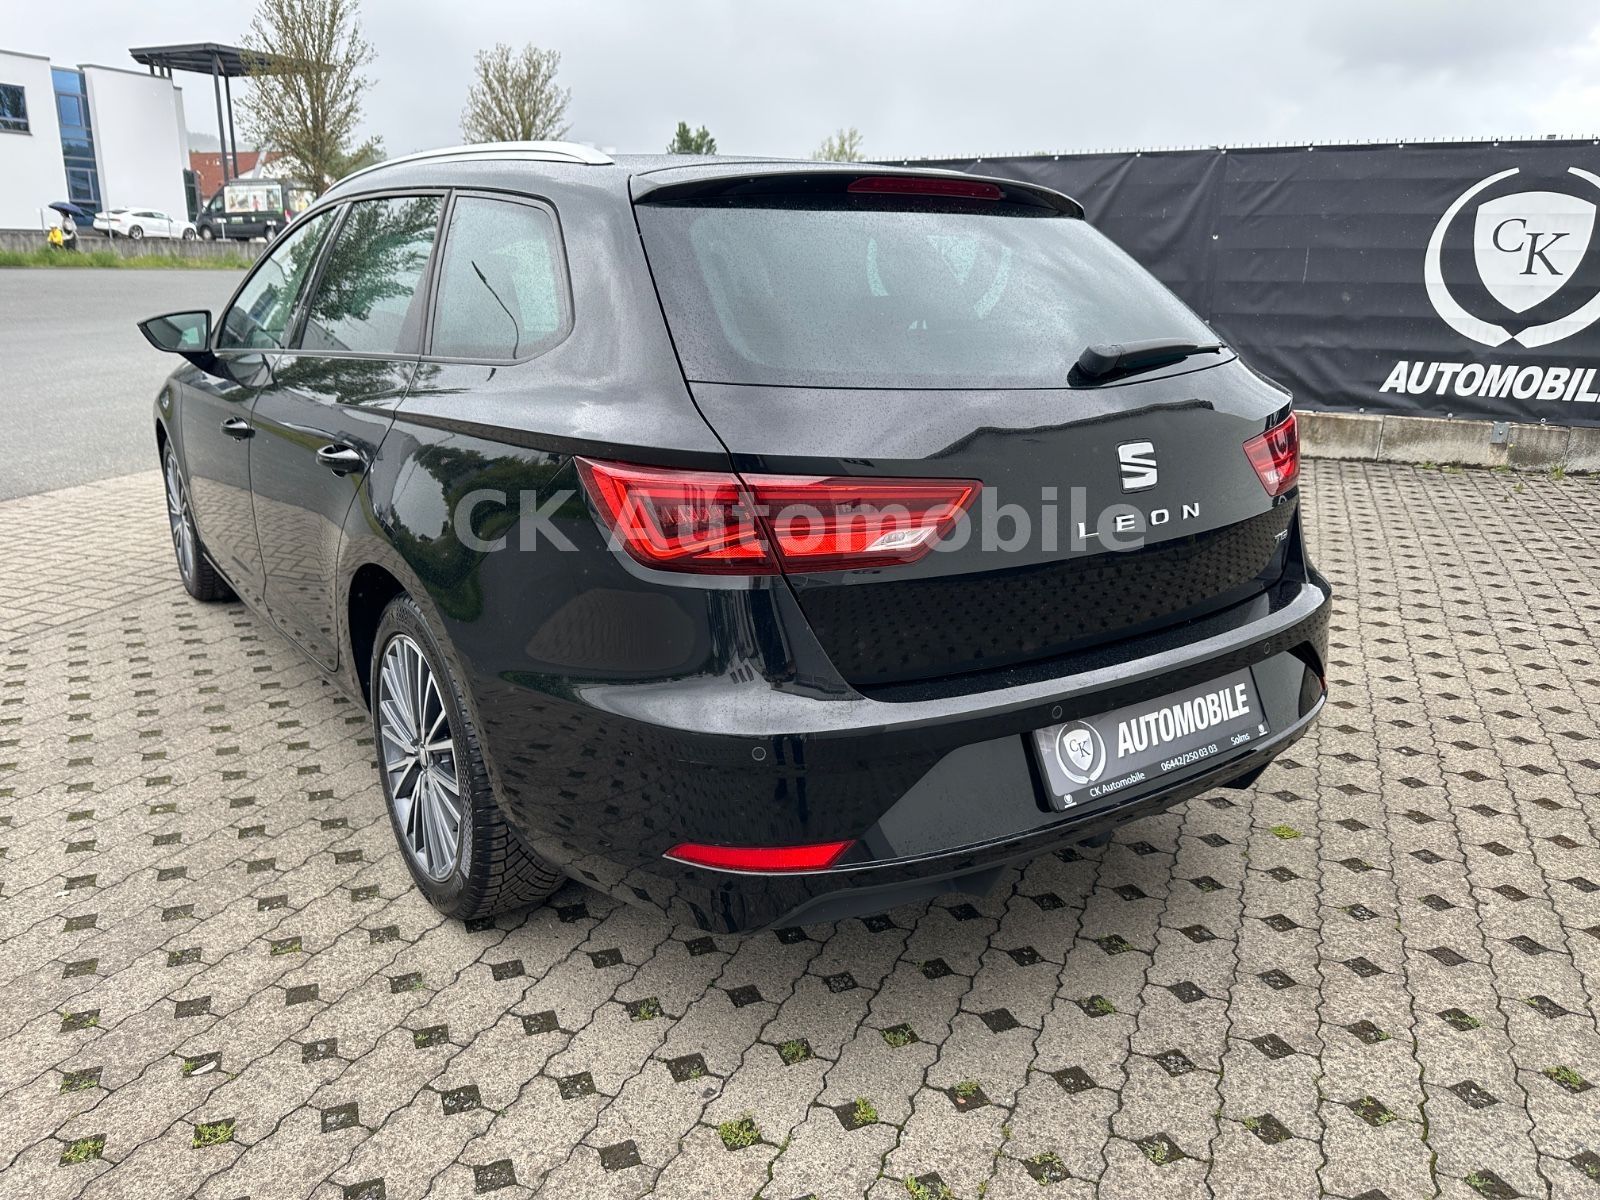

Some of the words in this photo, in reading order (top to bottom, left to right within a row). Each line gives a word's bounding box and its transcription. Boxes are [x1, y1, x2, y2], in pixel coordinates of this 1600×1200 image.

[1492, 218, 1570, 276] CK
[1378, 360, 1600, 403] AUTOMOBIL
[1077, 502, 1200, 539] LEON
[1117, 682, 1250, 758] AUTOMOBILE
[1069, 738, 1092, 758] CK
[1089, 786, 1102, 798] CK
[1102, 771, 1146, 794] Automobile
[1160, 751, 1199, 772] 06442/250
[1199, 747, 1209, 758] 03
[1208, 743, 1218, 754] 03
[1231, 732, 1251, 746] Solms
